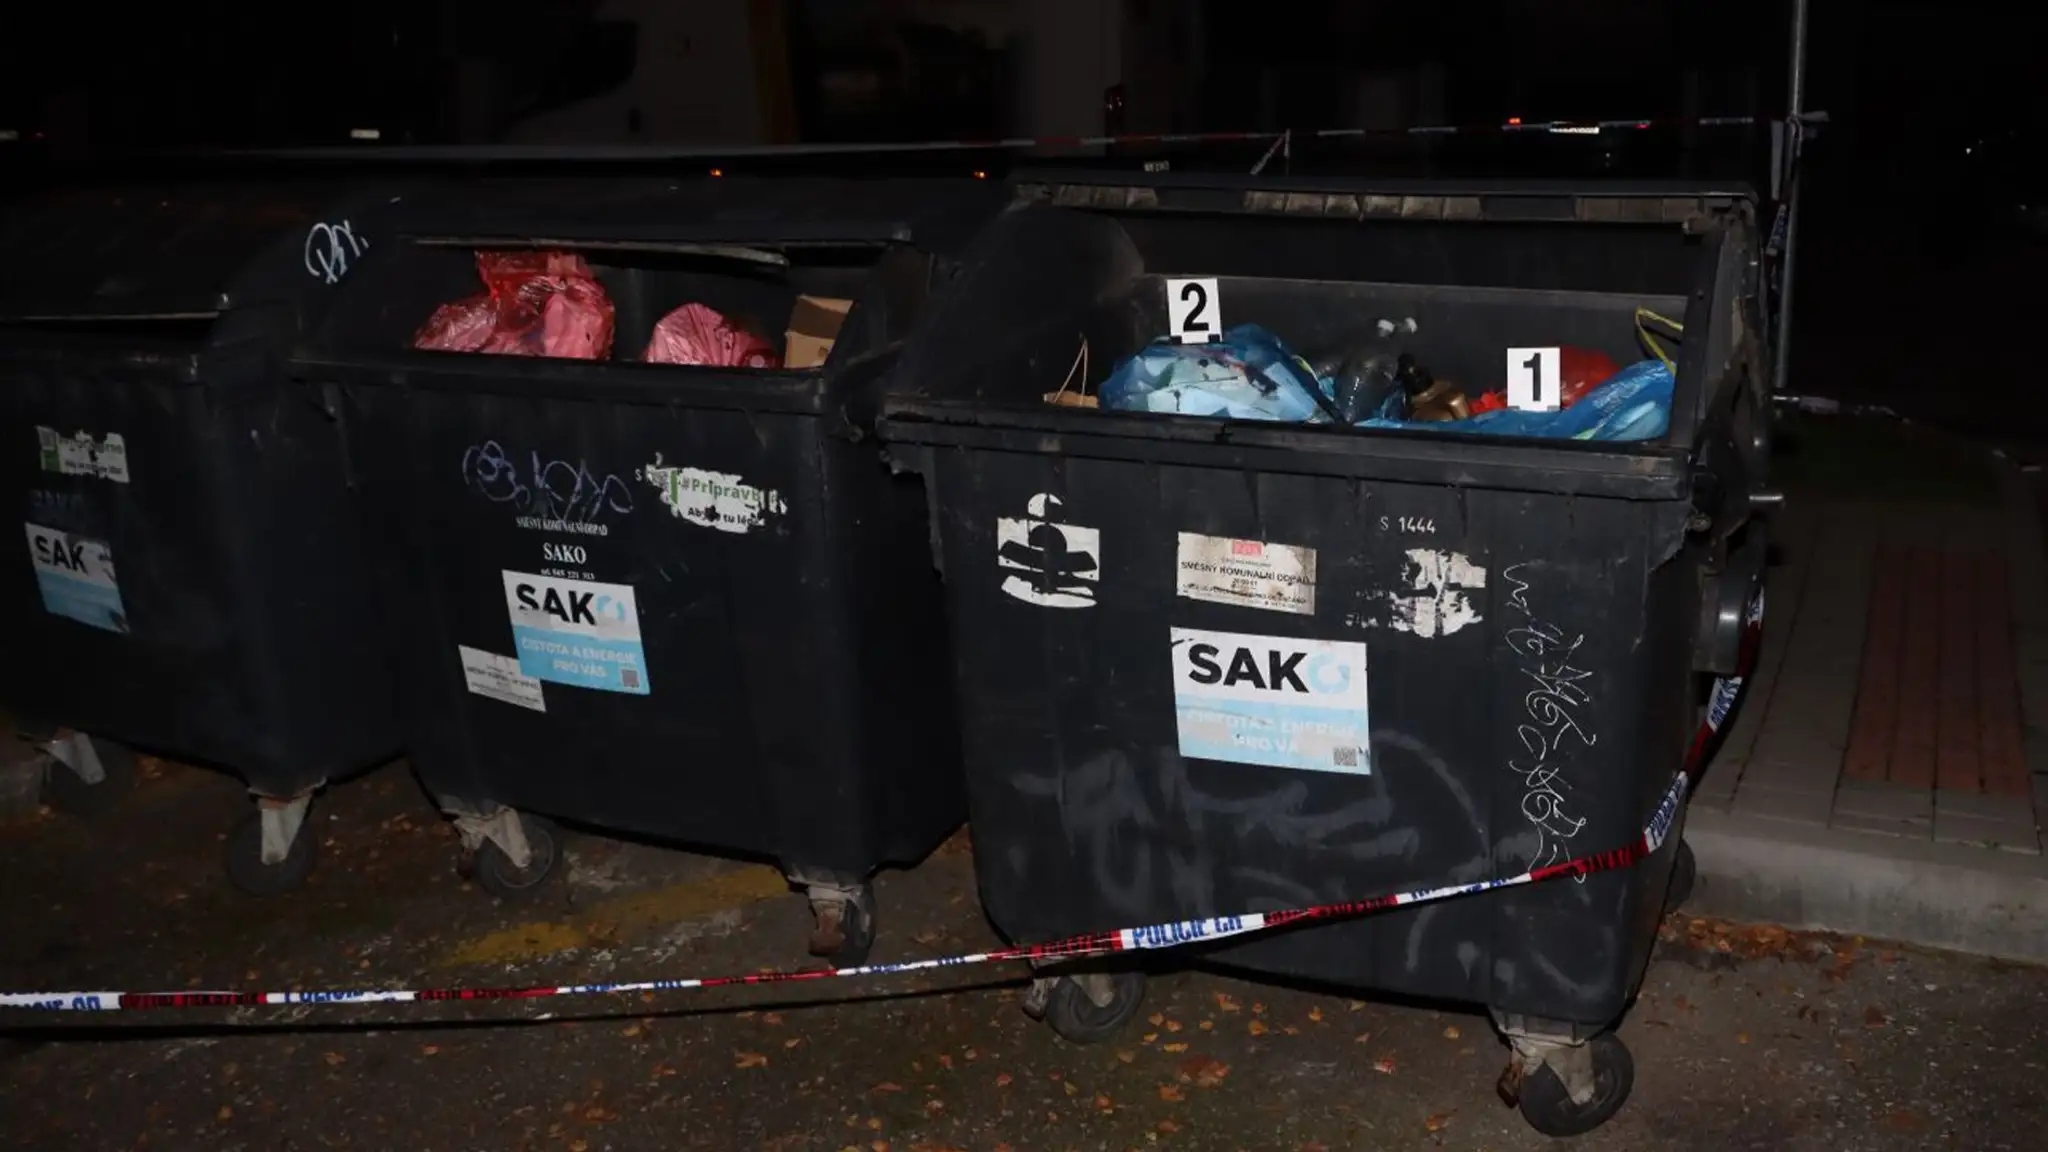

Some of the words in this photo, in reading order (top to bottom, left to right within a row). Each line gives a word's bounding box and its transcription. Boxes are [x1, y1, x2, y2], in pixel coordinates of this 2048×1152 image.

[1181, 282, 1209, 332] 2
[1523, 352, 1541, 402] 1
[1381, 517, 1388, 531] S
[1399, 517, 1436, 533] 1444
[543, 542, 586, 564] SAKO
[553, 660, 578, 674] PRO
